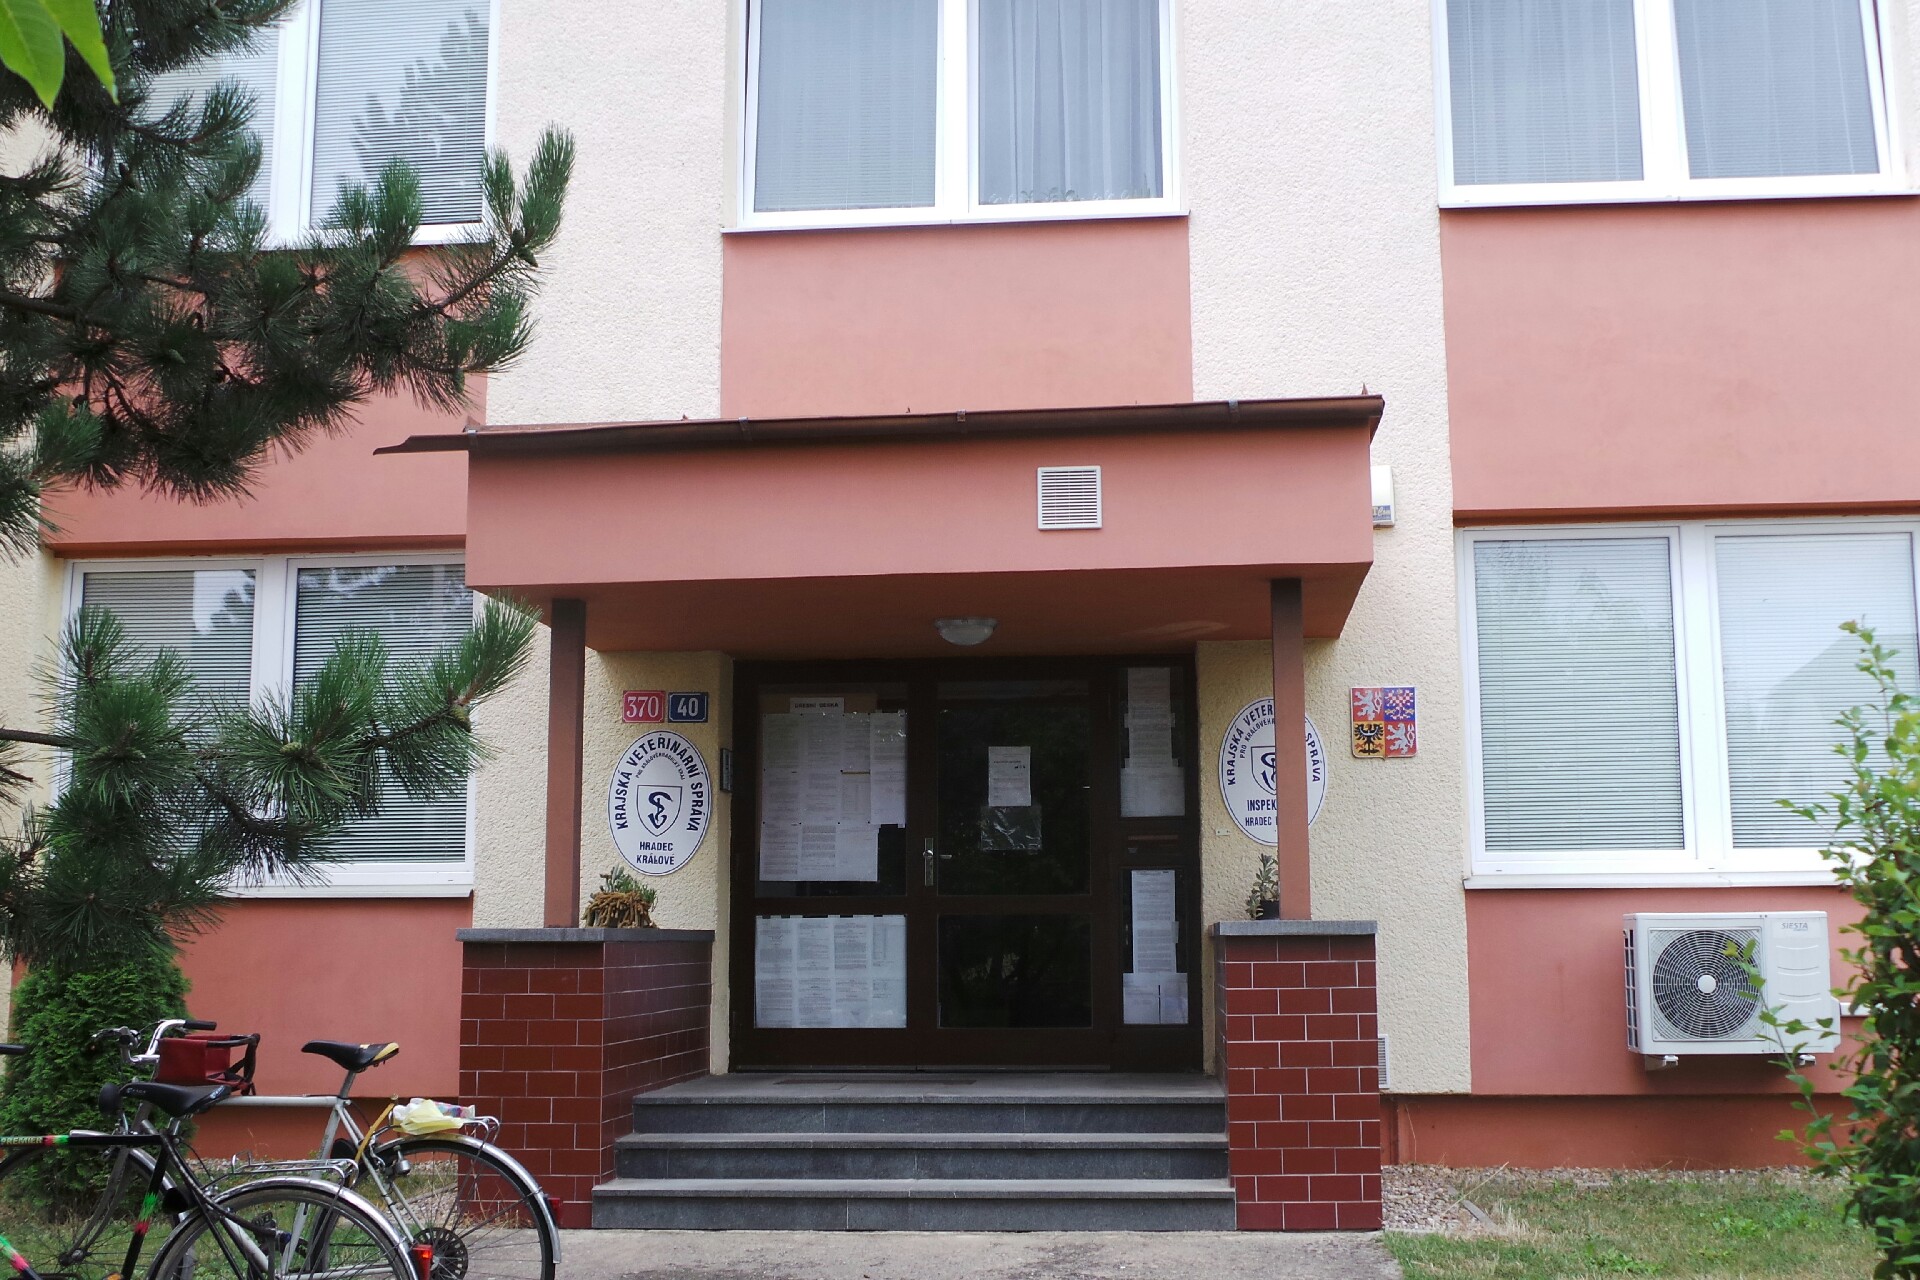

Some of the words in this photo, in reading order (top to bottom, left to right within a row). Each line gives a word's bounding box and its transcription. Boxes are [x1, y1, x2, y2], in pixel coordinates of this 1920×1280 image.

[626, 695, 659, 718] 370
[677, 697, 699, 717] 40
[1226, 725, 1245, 786] KRAJSKÁ
[1243, 704, 1274, 726] VETER
[1239, 744, 1247, 759] PRO
[614, 769, 633, 830] KRAJSKÁ
[626, 736, 704, 778] VETERINÁRNÍ
[686, 781, 706, 832] SPRÁVA
[1246, 799, 1277, 811] INSPEK
[1245, 816, 1272, 826] HRADEC
[639, 841, 674, 852] HRADEC
[636, 852, 675, 865] KRÁLOVÉ
[0, 1136, 43, 1145] PREMIER
